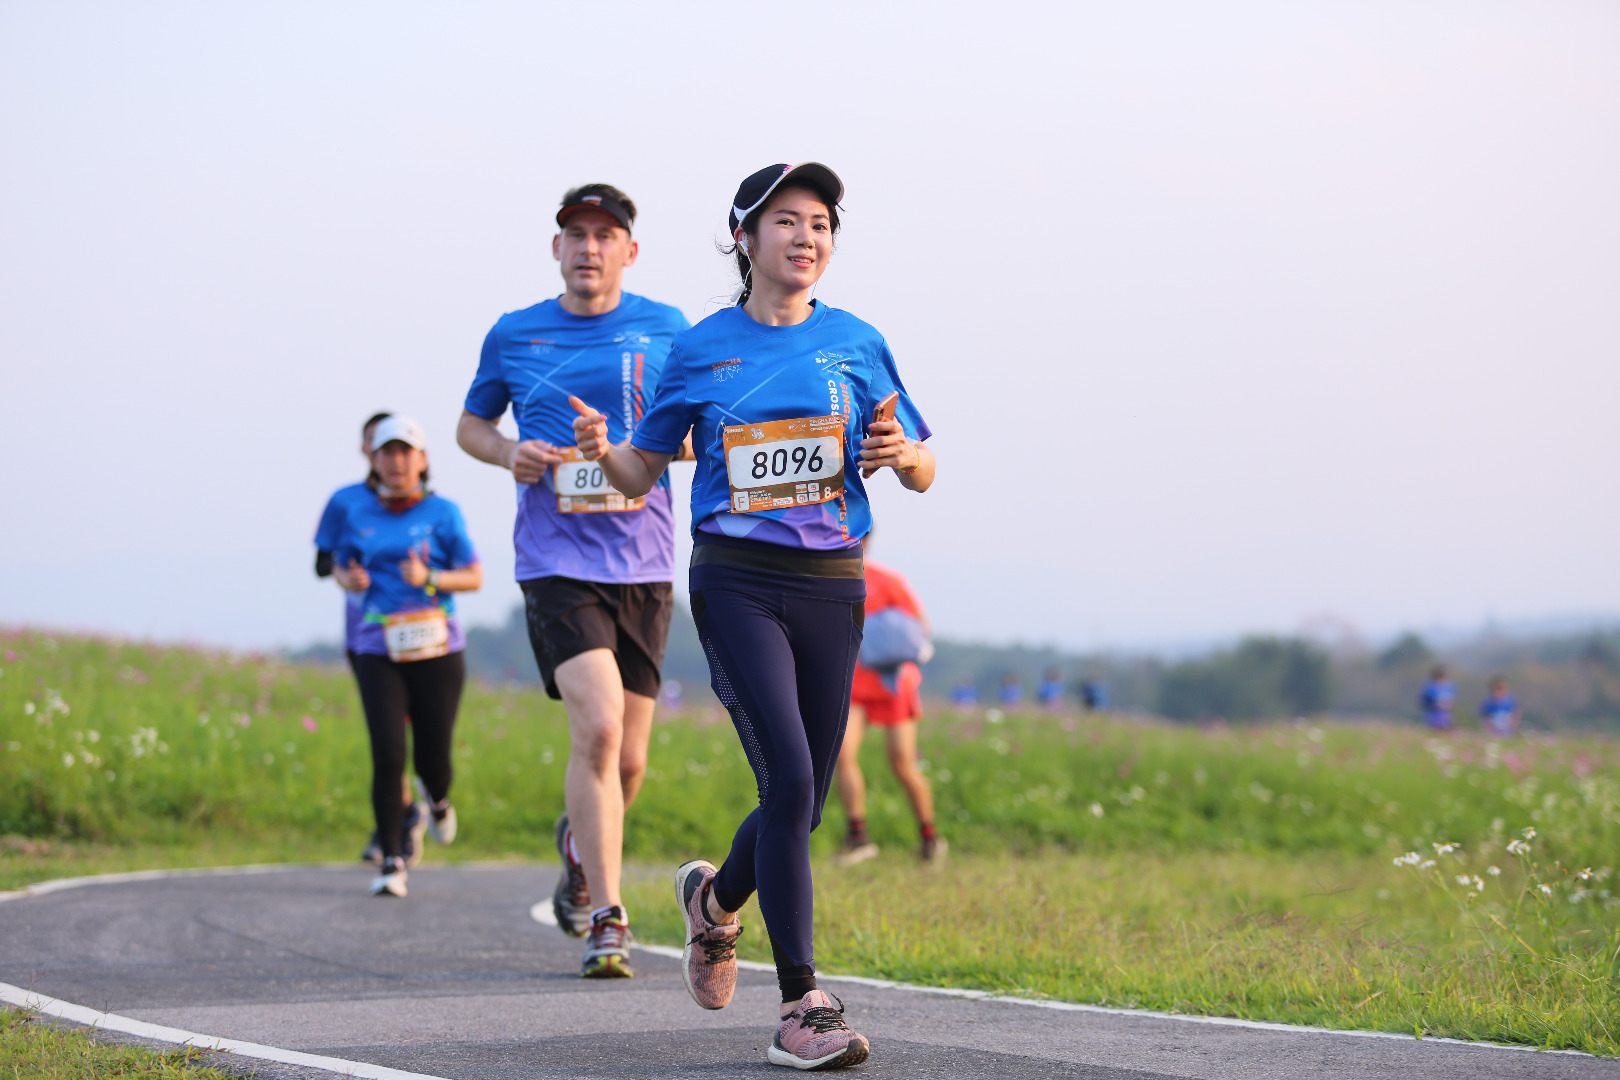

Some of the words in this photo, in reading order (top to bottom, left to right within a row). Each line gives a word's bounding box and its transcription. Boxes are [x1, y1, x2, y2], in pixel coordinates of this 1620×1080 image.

[711, 358, 742, 370] SINGHA
[828, 380, 840, 416] CROSS
[751, 445, 824, 480] 8096
[737, 496, 746, 509] F
